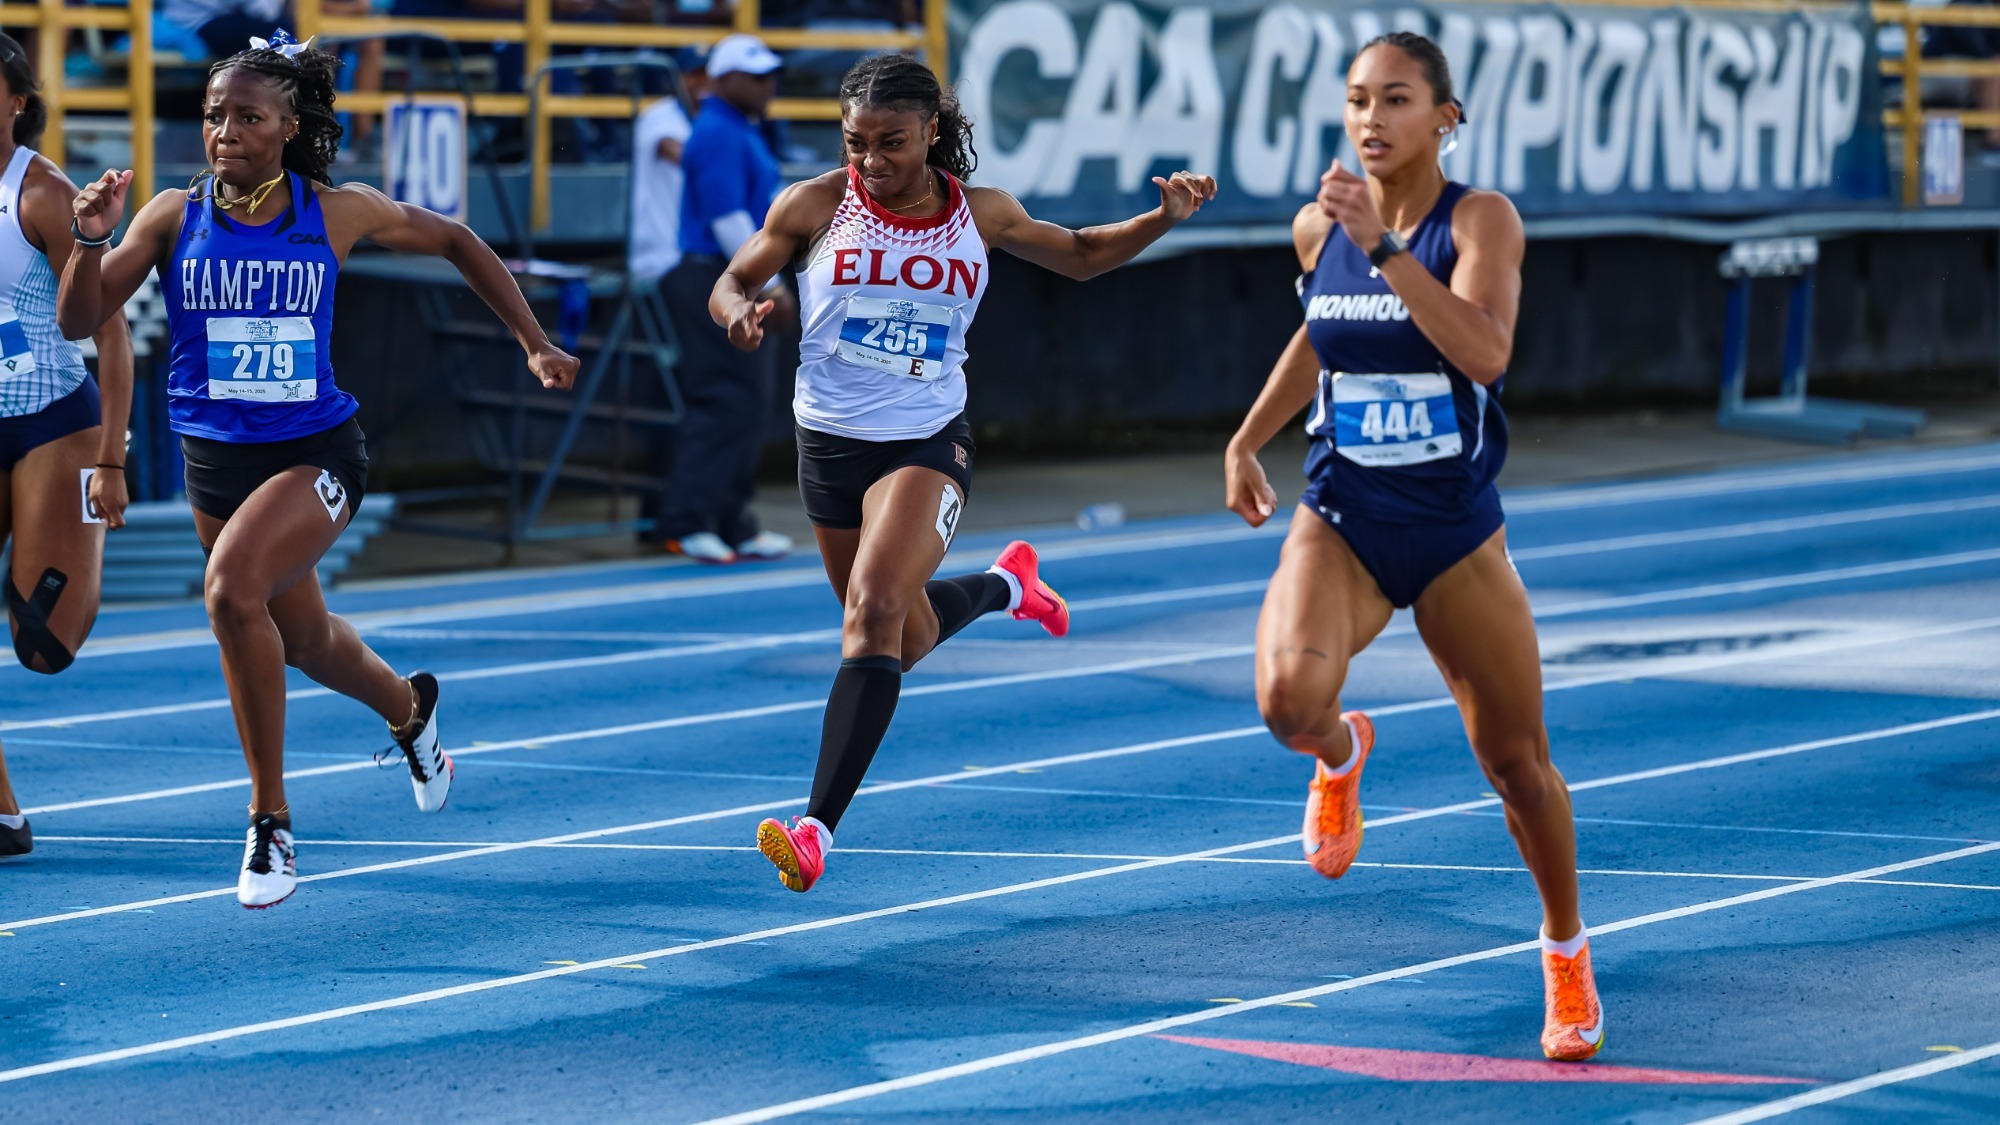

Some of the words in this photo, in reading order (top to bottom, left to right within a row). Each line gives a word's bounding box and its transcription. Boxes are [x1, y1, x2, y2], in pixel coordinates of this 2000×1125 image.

[957, 2, 1224, 200] CAA
[1232, 4, 1865, 197] CHMPIONSHIP
[389, 108, 460, 210] 40
[288, 233, 326, 246] CAA
[182, 258, 326, 314] HAMPTON
[831, 248, 982, 299] ELON
[1305, 294, 1409, 321] MONMOU
[861, 318, 929, 356] 255
[232, 343, 294, 380] 279
[908, 358, 925, 377] E
[1361, 400, 1433, 443] 444
[951, 441, 967, 469] E
[943, 499, 959, 543] 4
